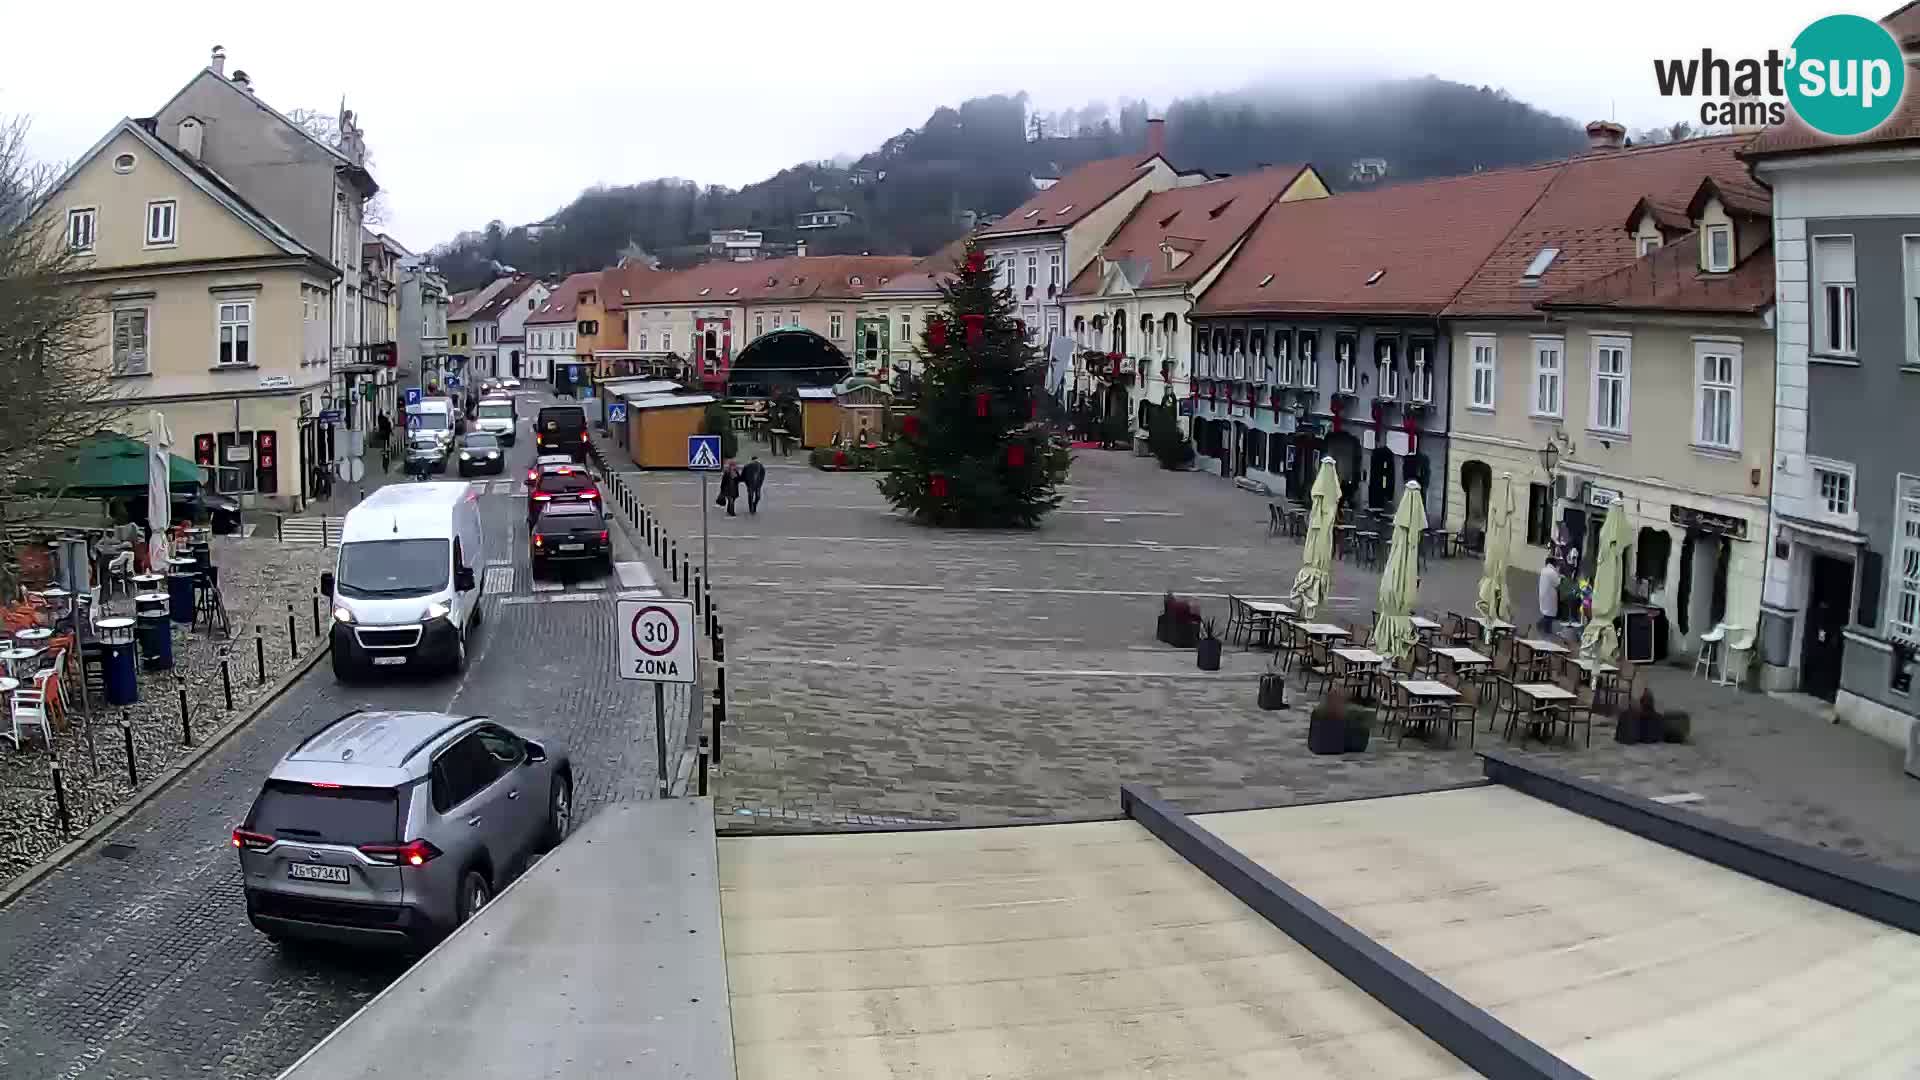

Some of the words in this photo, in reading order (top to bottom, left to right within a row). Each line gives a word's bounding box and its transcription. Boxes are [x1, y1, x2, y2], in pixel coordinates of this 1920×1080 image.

[409, 391, 416, 402] P
[644, 622, 668, 642] 30
[634, 659, 679, 675] ZONA
